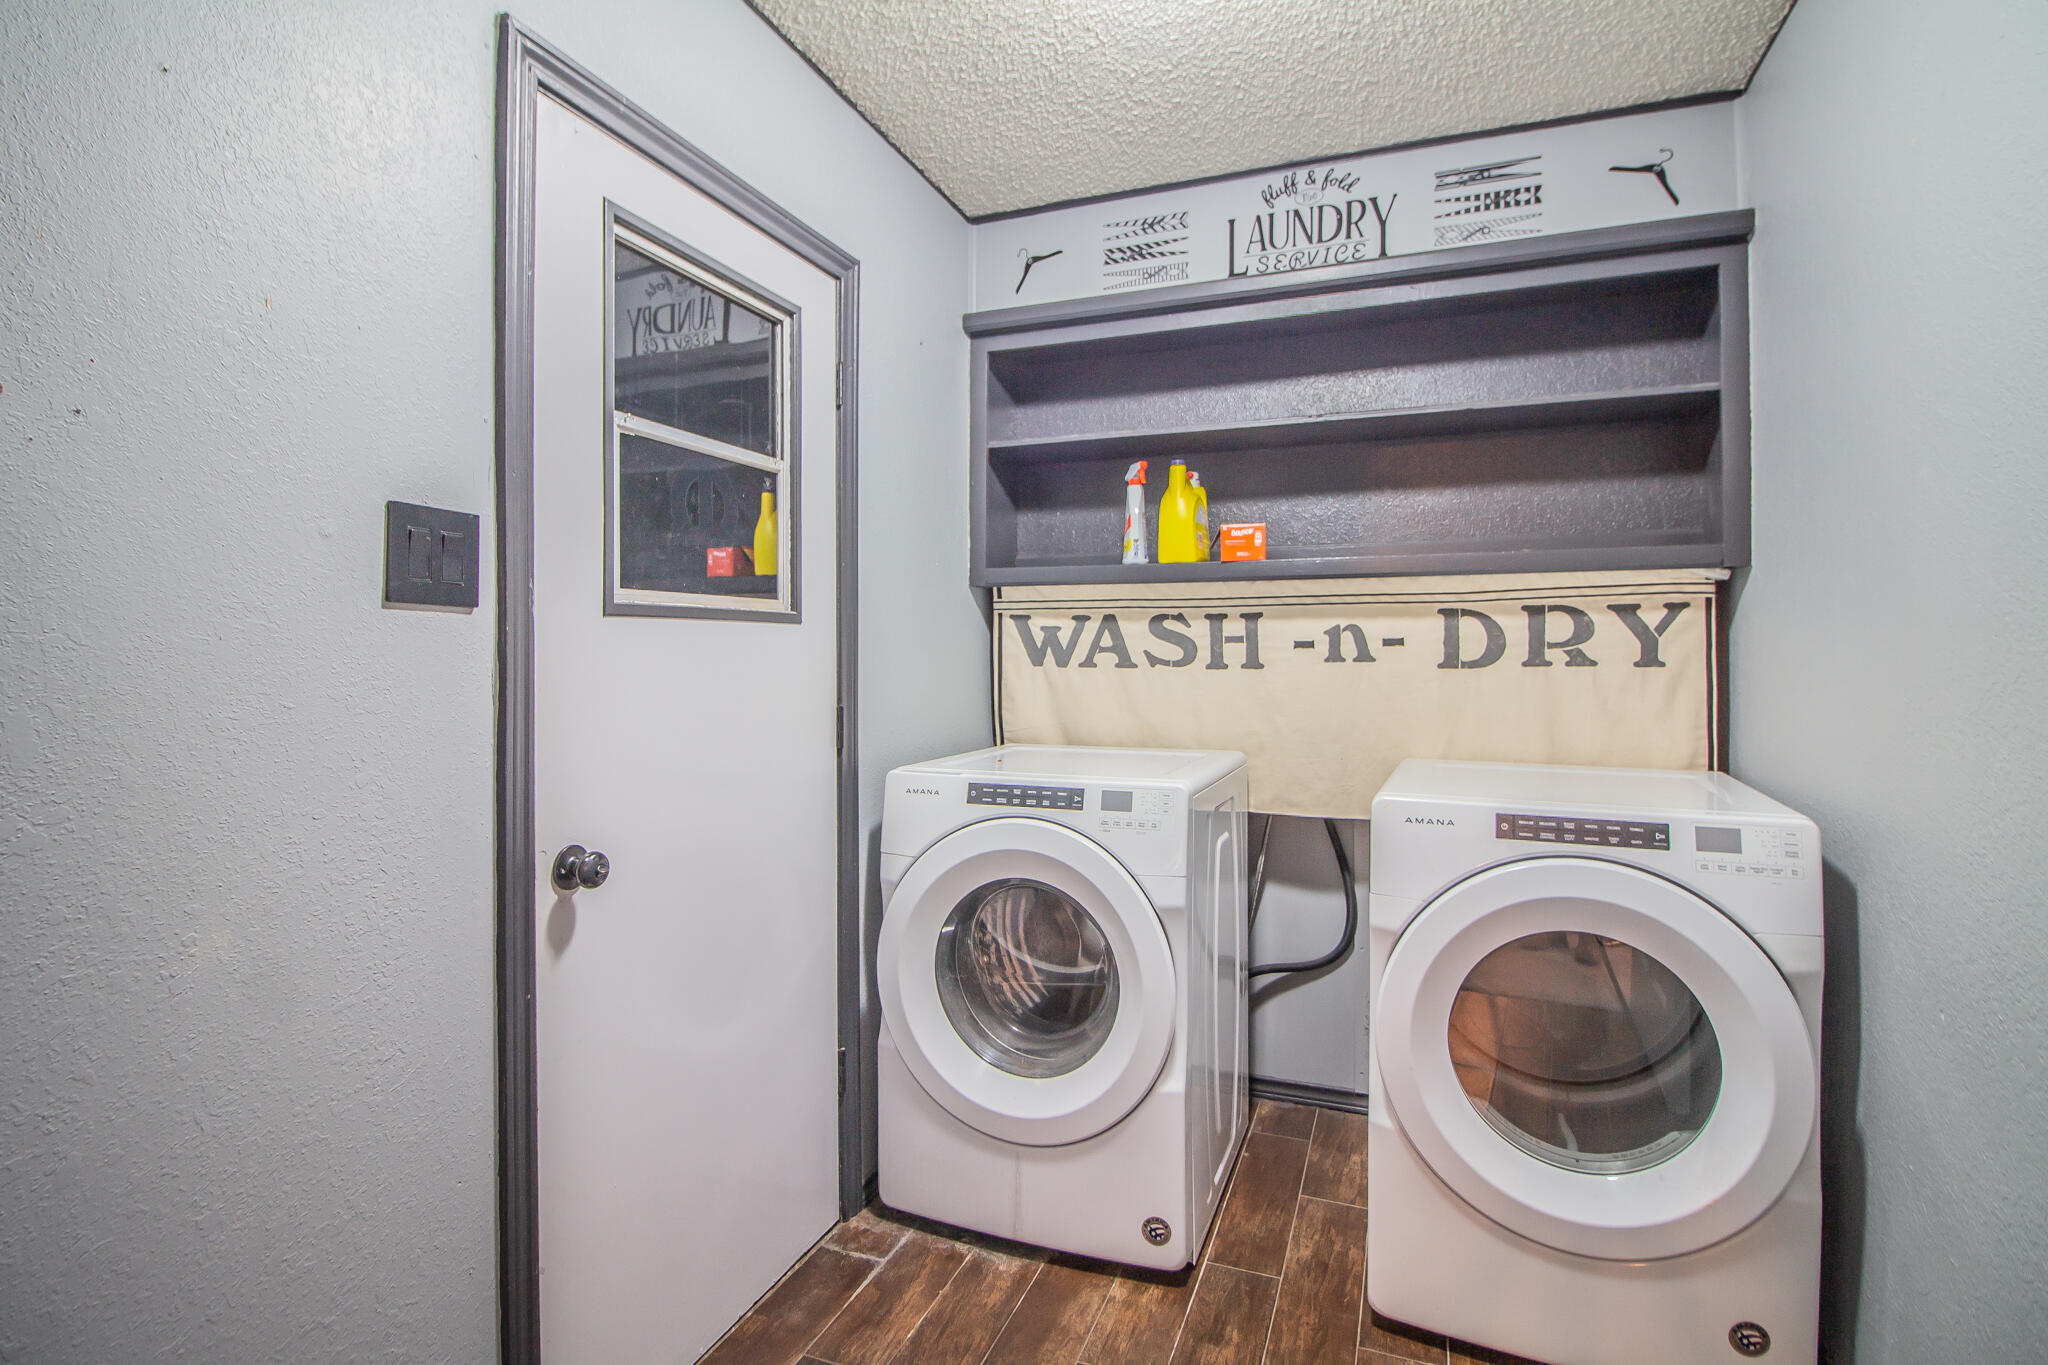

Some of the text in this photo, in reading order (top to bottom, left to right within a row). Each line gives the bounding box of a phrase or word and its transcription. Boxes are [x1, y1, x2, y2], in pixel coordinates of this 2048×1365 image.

[1261, 168, 1361, 208] fluff & fold
[1227, 193, 1398, 278] LAUNDRY
[1256, 242, 1367, 274] SERVICE
[1009, 612, 1265, 669] WASH
[1437, 602, 1691, 669] DRY
[905, 788, 940, 796] AMANA
[1404, 816, 1455, 826] AMANA
